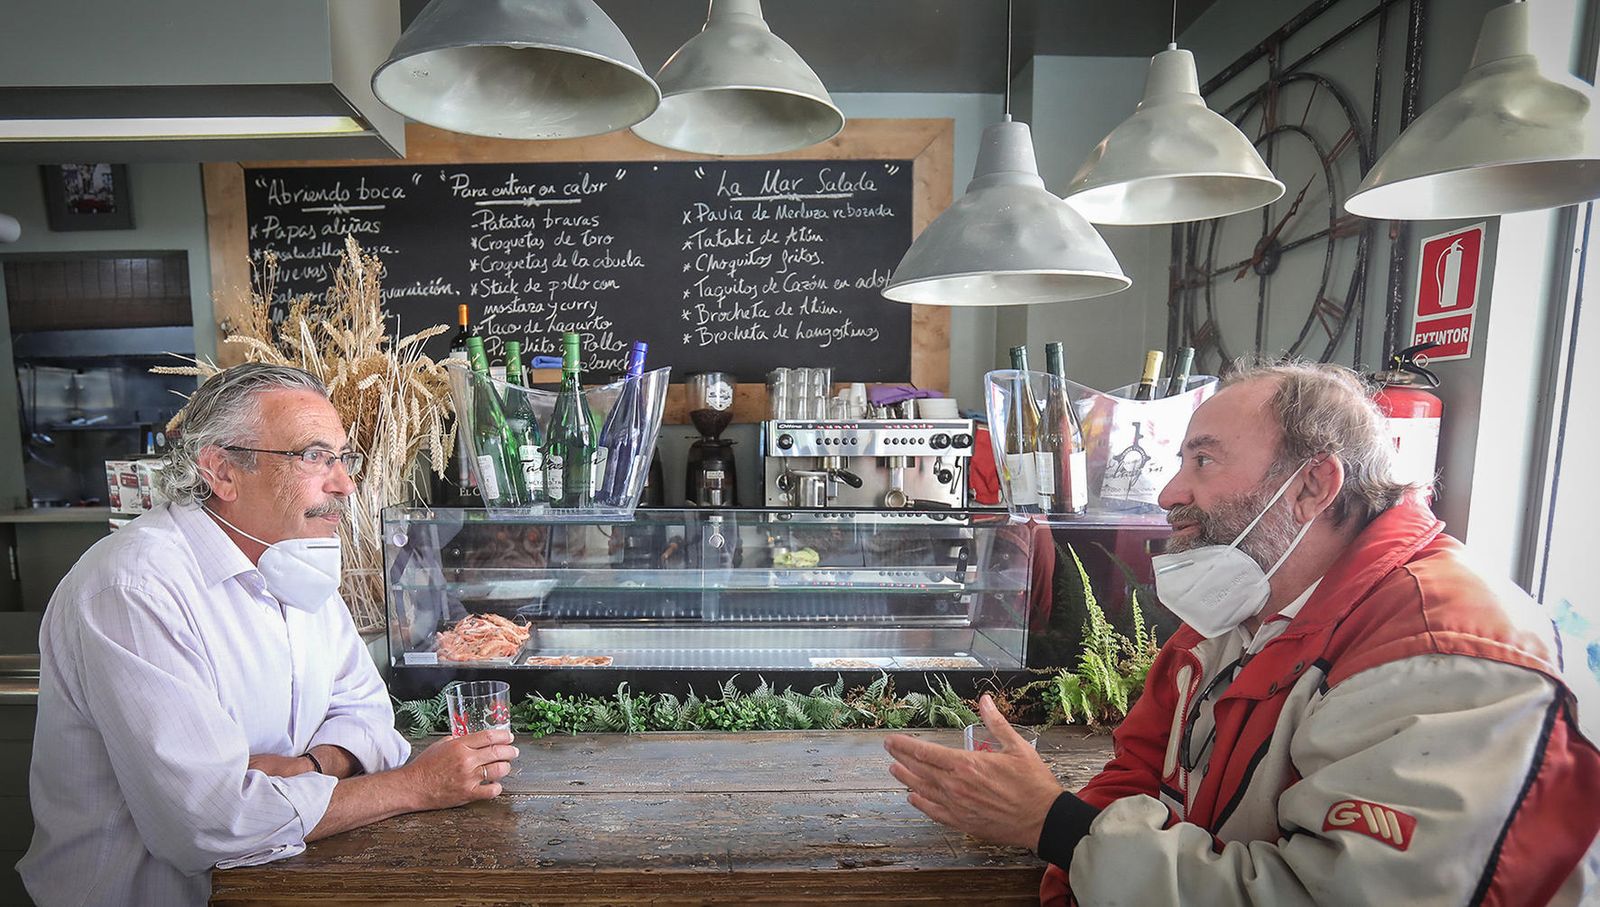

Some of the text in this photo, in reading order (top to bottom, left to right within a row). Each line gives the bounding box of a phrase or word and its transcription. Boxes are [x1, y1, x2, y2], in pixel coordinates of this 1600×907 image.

[492, 173, 535, 197] entrar
[760, 168, 804, 195] Mar
[472, 208, 600, 232] Patatas bravas
[752, 203, 770, 221] de
[775, 204, 830, 221] Merluza
[261, 215, 317, 244] Papas
[688, 228, 755, 250] Tataki
[759, 229, 780, 245] de
[478, 231, 545, 255] Croquetas
[554, 230, 576, 246] de
[480, 249, 645, 279] Croquetas de la abuela
[695, 247, 773, 278] Choquitos
[480, 274, 621, 300] Stick de pollo con
[693, 275, 759, 309] Taquitos
[762, 276, 780, 293] de
[833, 280, 850, 291] en
[483, 297, 598, 320] mostaza y curry
[694, 300, 771, 325] Brocheta
[775, 299, 794, 317] de
[480, 314, 522, 336] Taco
[524, 319, 544, 334] de
[695, 322, 769, 347] Brocheta
[773, 323, 790, 340] de
[1415, 326, 1470, 346] EXTINTOR
[580, 331, 629, 352] Pollo
